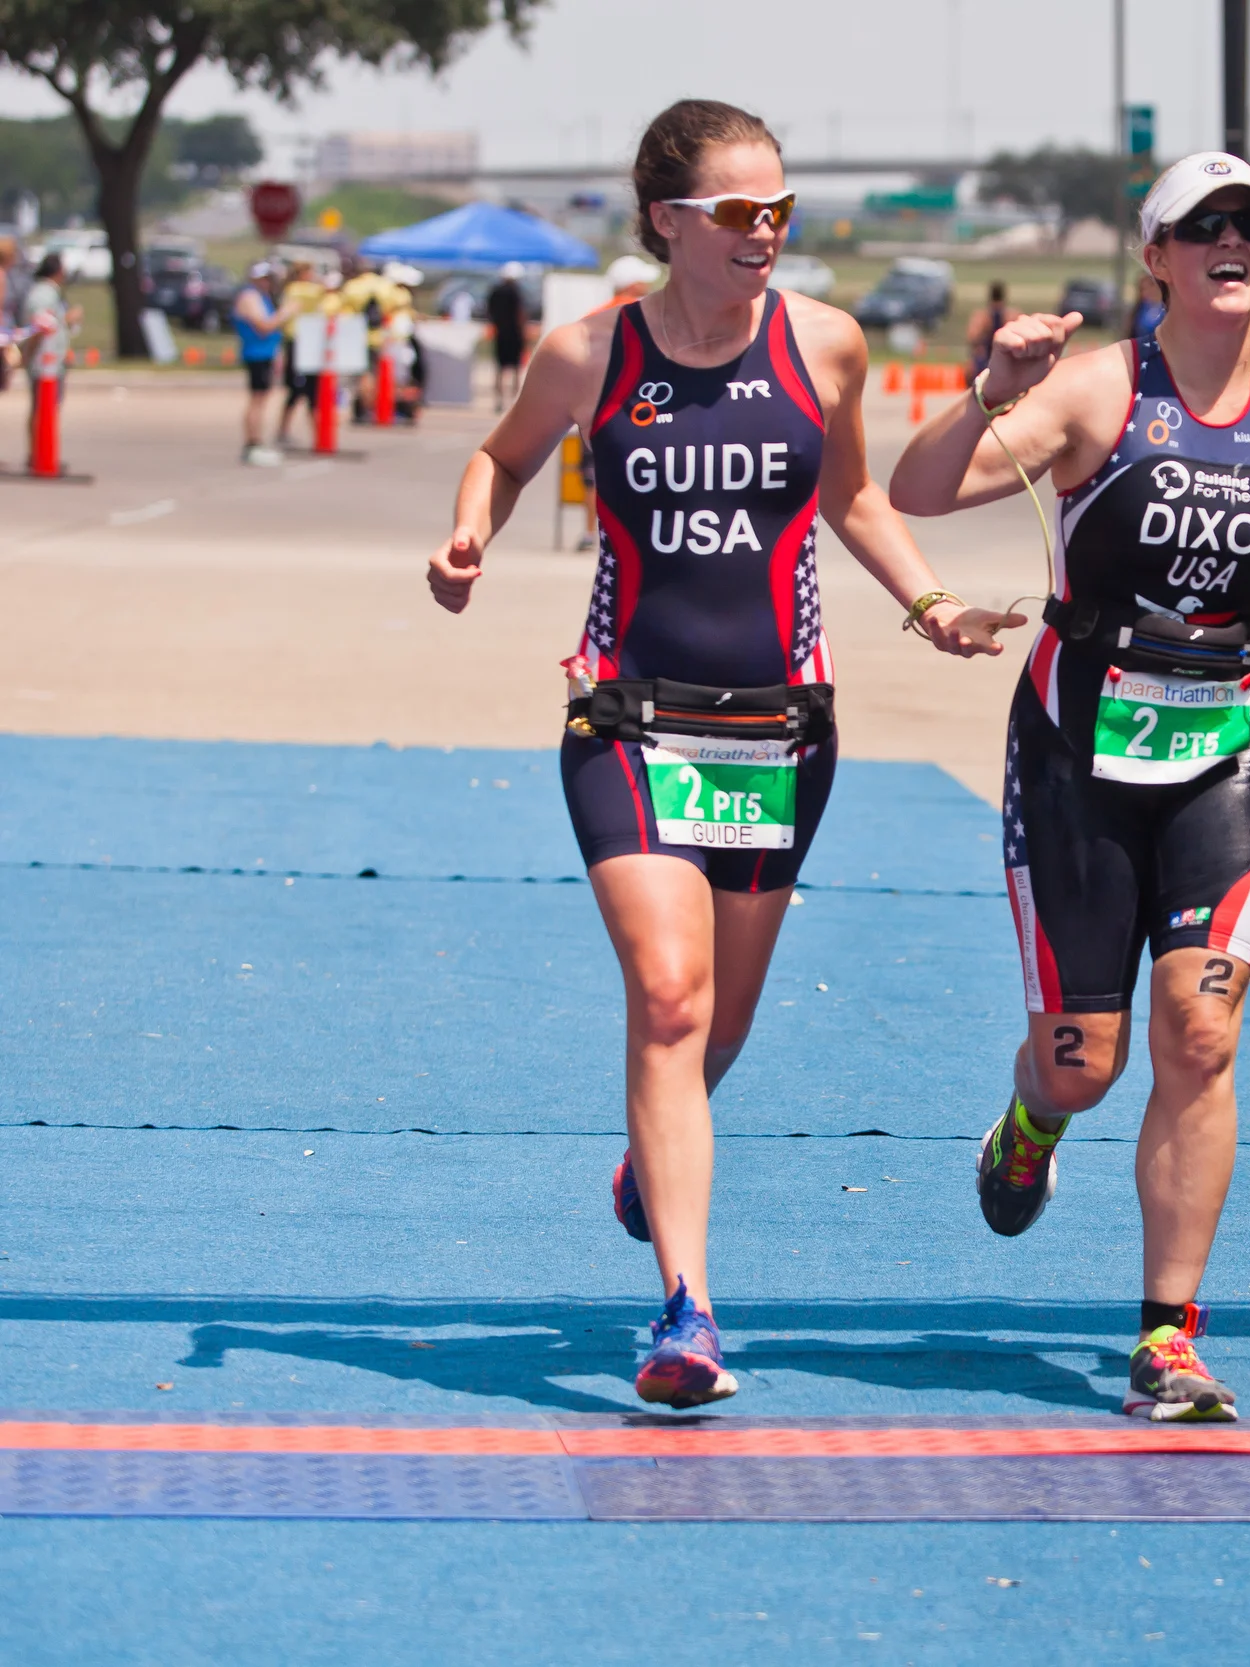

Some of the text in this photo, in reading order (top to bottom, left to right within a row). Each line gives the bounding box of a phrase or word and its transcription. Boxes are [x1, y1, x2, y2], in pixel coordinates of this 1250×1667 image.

[726, 379, 772, 400] TYR
[626, 442, 788, 493] GUIDE
[1194, 470, 1250, 491] Guiding
[1193, 483, 1220, 498] For
[1221, 486, 1250, 503] The
[651, 508, 763, 556] USA
[1166, 554, 1238, 593] USA
[1120, 680, 1234, 703] paratriathlon
[1125, 706, 1220, 760] 2 PT5
[679, 765, 762, 822] 2 PT5
[692, 823, 753, 845] GUIDE
[1199, 958, 1234, 995] 2
[1053, 1025, 1086, 1068] 2
